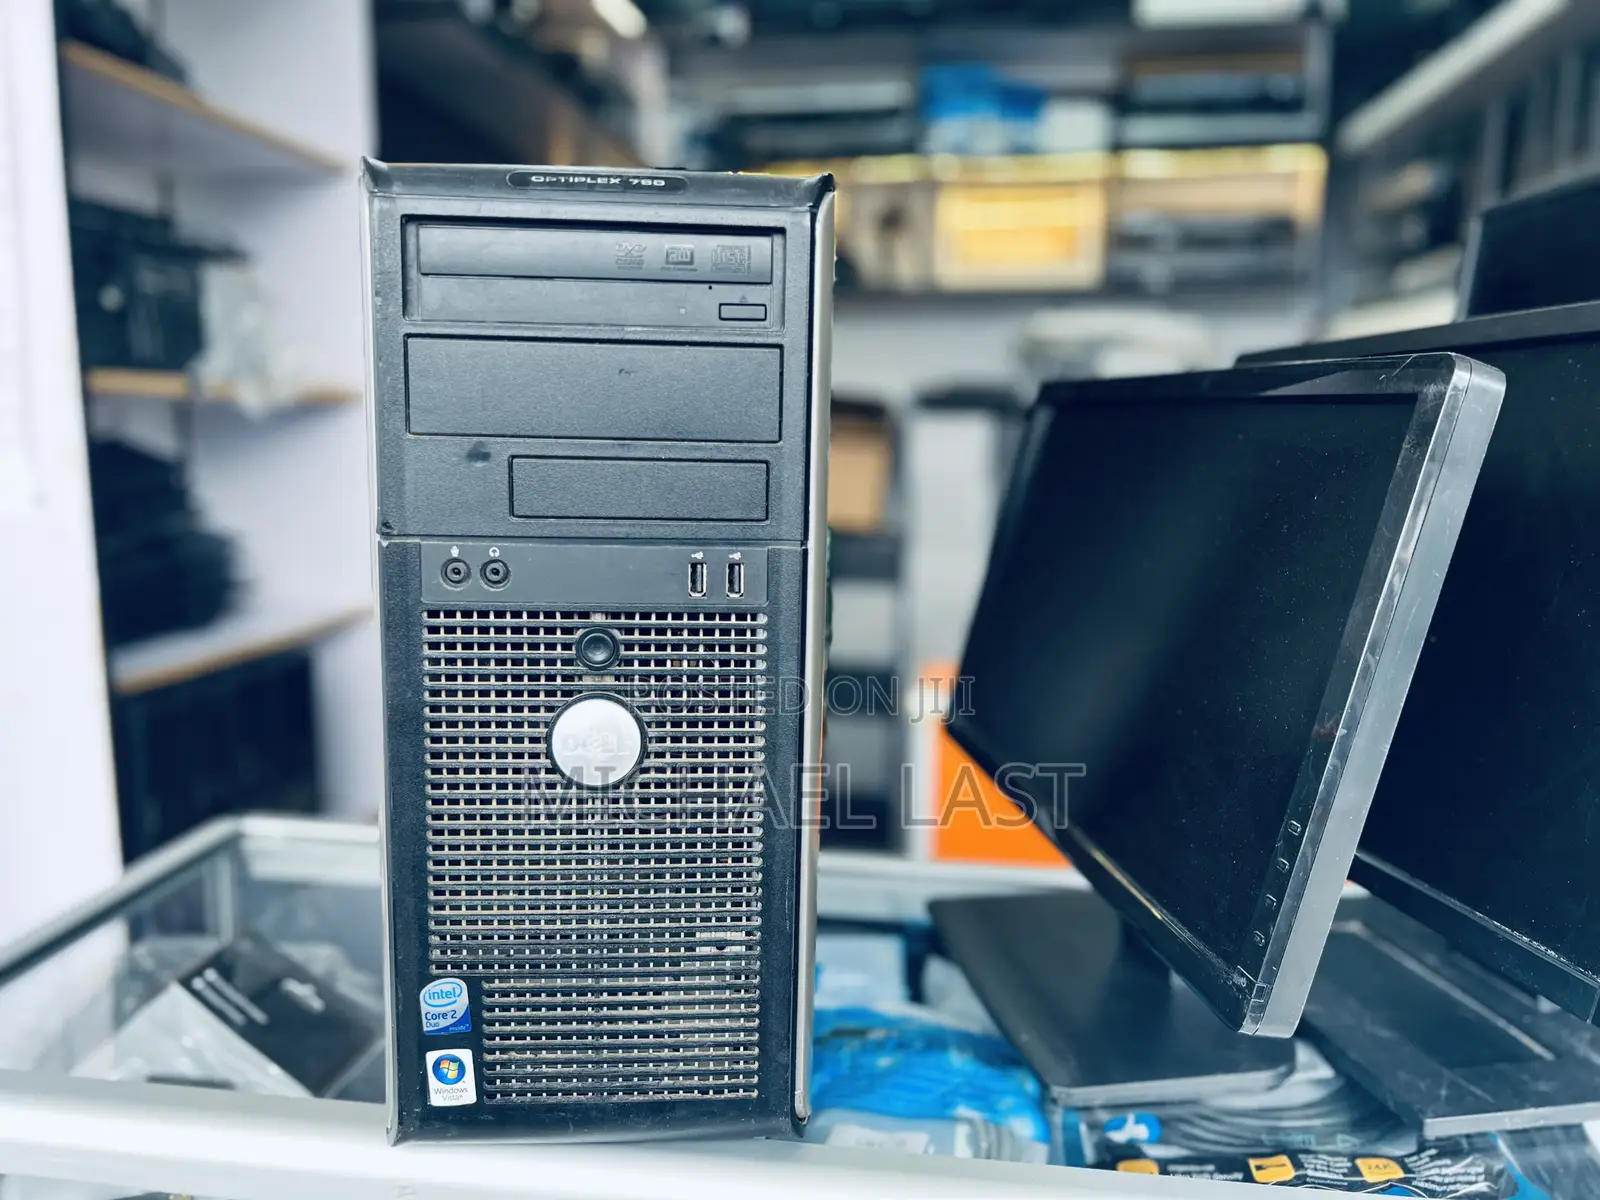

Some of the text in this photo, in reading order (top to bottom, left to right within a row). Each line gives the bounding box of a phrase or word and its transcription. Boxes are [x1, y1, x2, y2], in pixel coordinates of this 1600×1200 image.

[530, 175, 621, 184] OPTIPLEX
[560, 732, 631, 756] DELL
[428, 987, 457, 1000] intel
[425, 1021, 440, 1029] Duo
[433, 1086, 469, 1096] Windows
